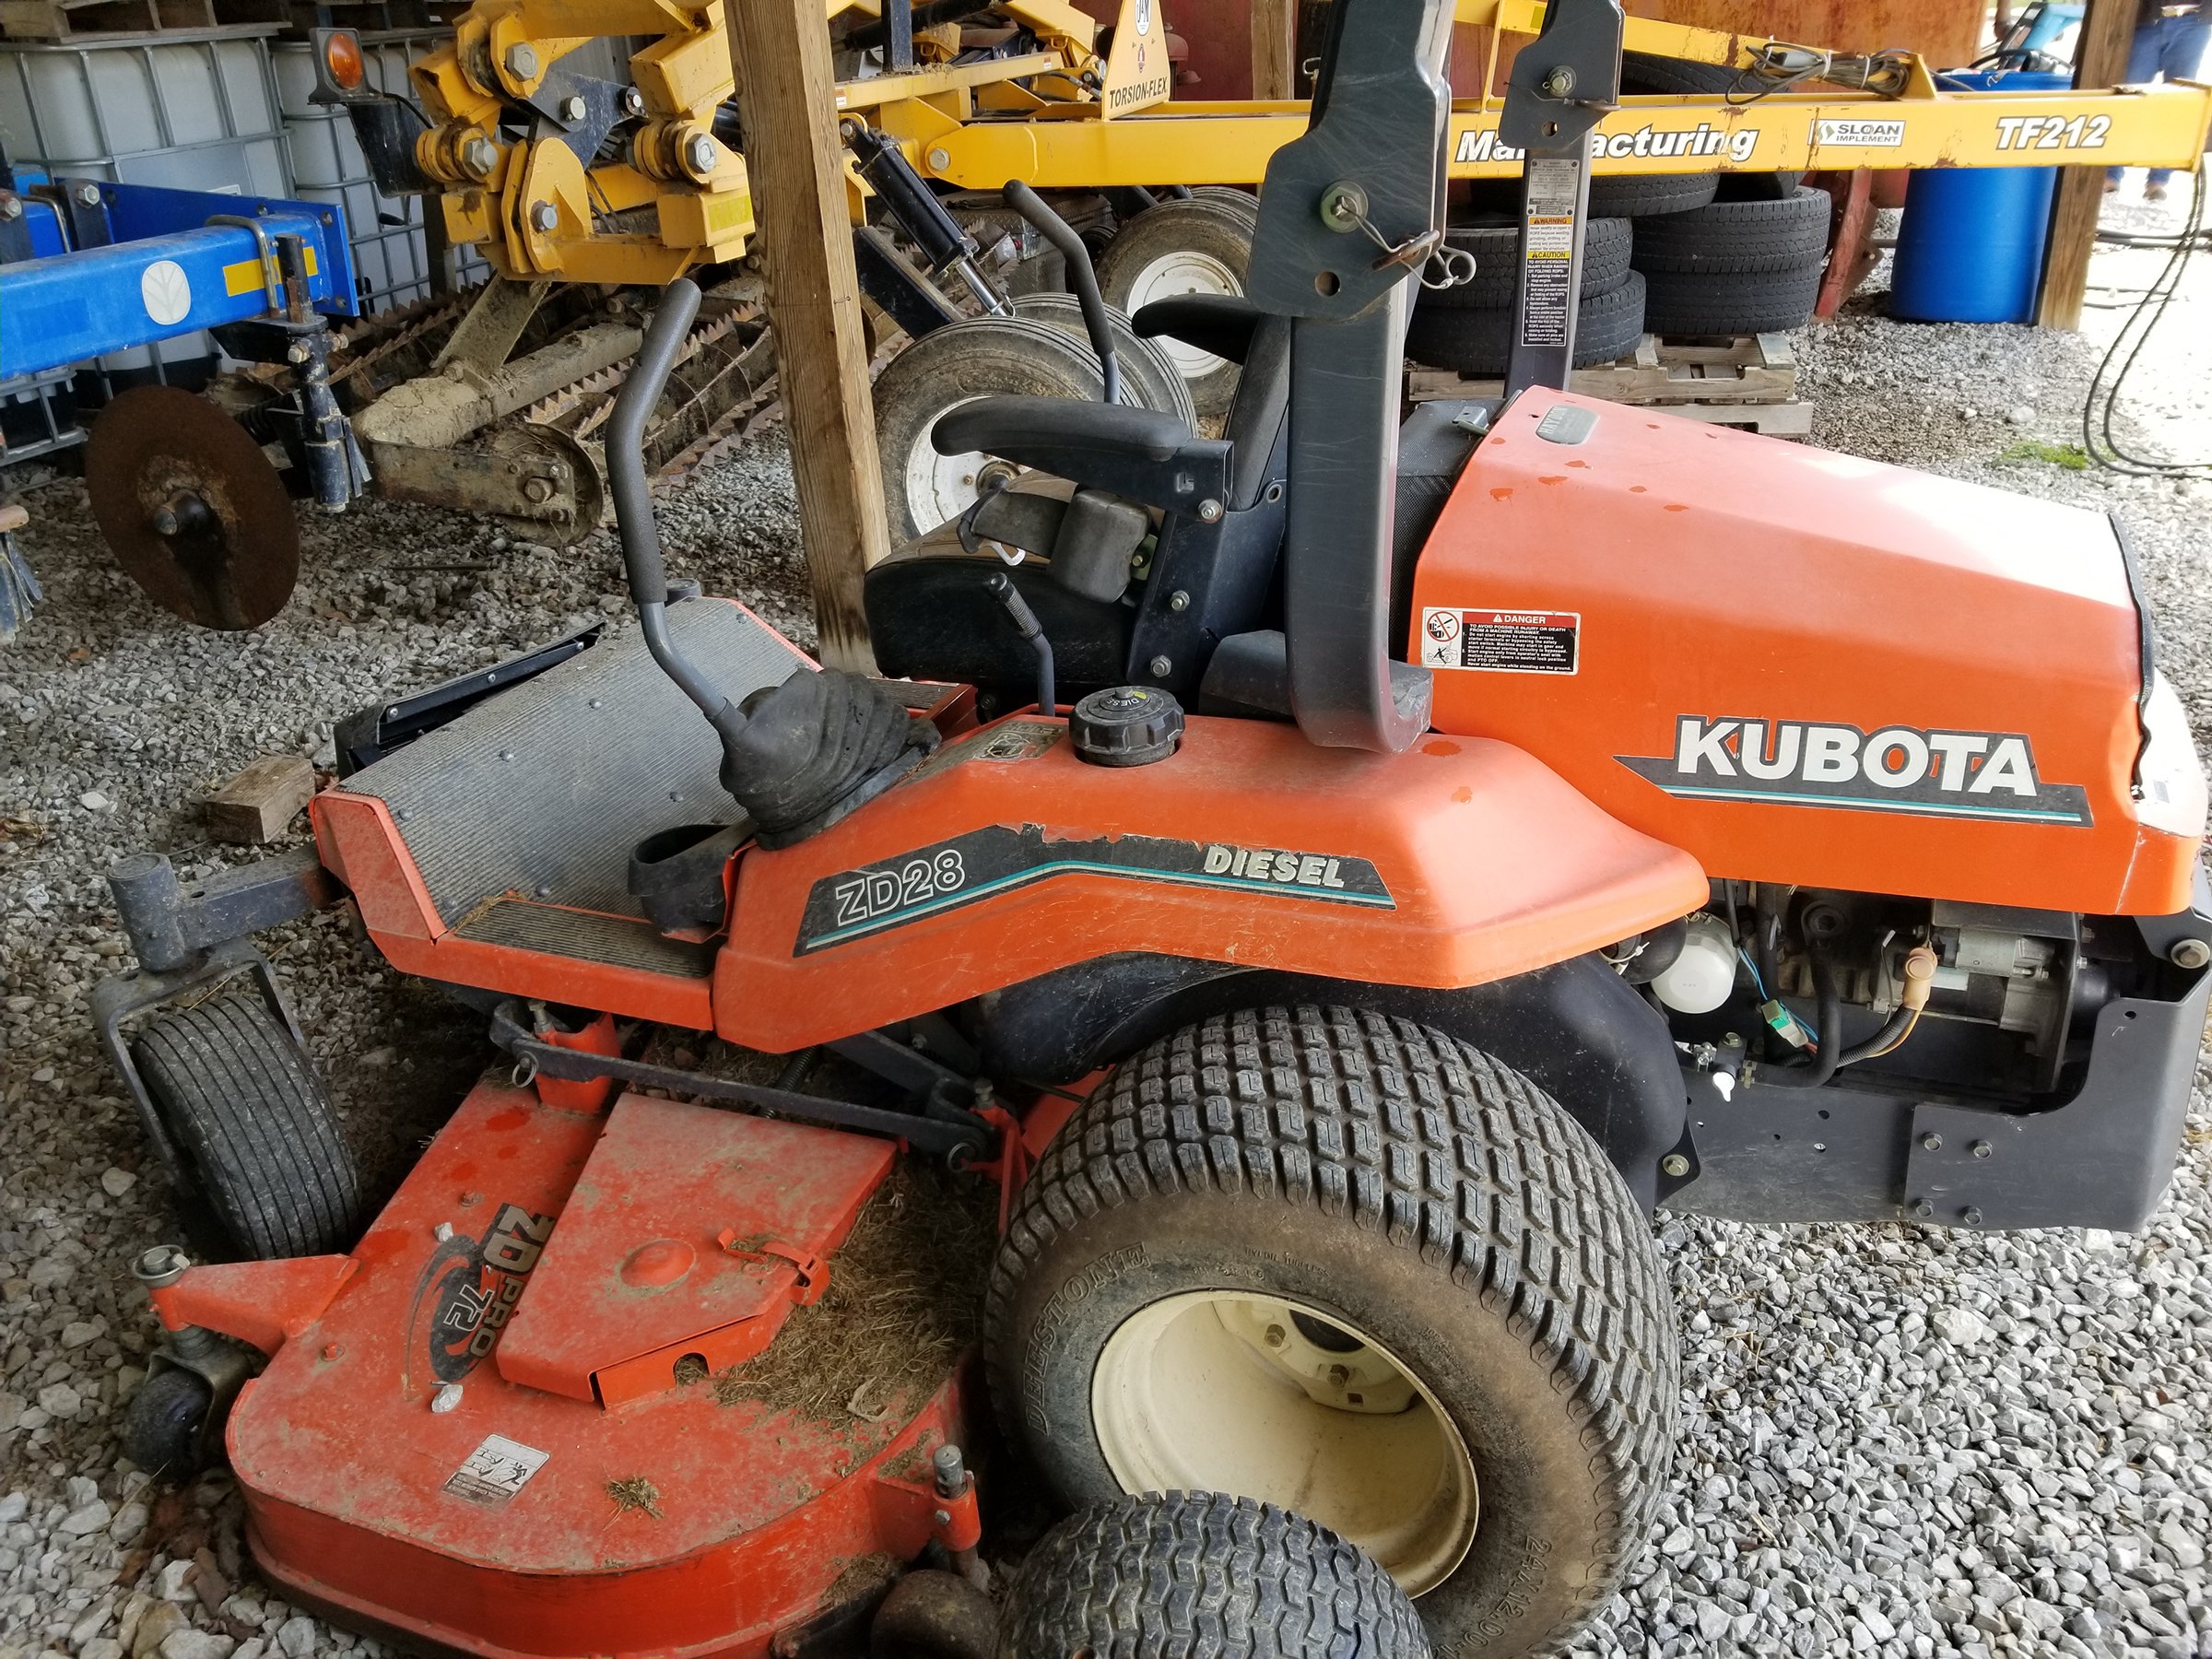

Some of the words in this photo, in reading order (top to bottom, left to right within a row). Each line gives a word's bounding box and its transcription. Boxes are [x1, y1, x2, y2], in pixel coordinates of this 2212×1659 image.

[1109, 76, 1168, 109] TORSION-FLEX
[1454, 121, 1760, 162] Maacturing
[1838, 124, 1901, 135] SLOAN
[1995, 113, 2113, 150] TF212
[1504, 615, 1546, 624] DANGER
[1677, 720, 2038, 796] KUBOTA
[835, 849, 965, 927] ZD28
[1202, 845, 1345, 888] DIESEL
[443, 1284, 495, 1331] 72
[470, 1277, 525, 1358] PRO
[1023, 1241, 1152, 1437] DEESTONE
[1431, 1535, 1553, 1659] 24X12.00-1
